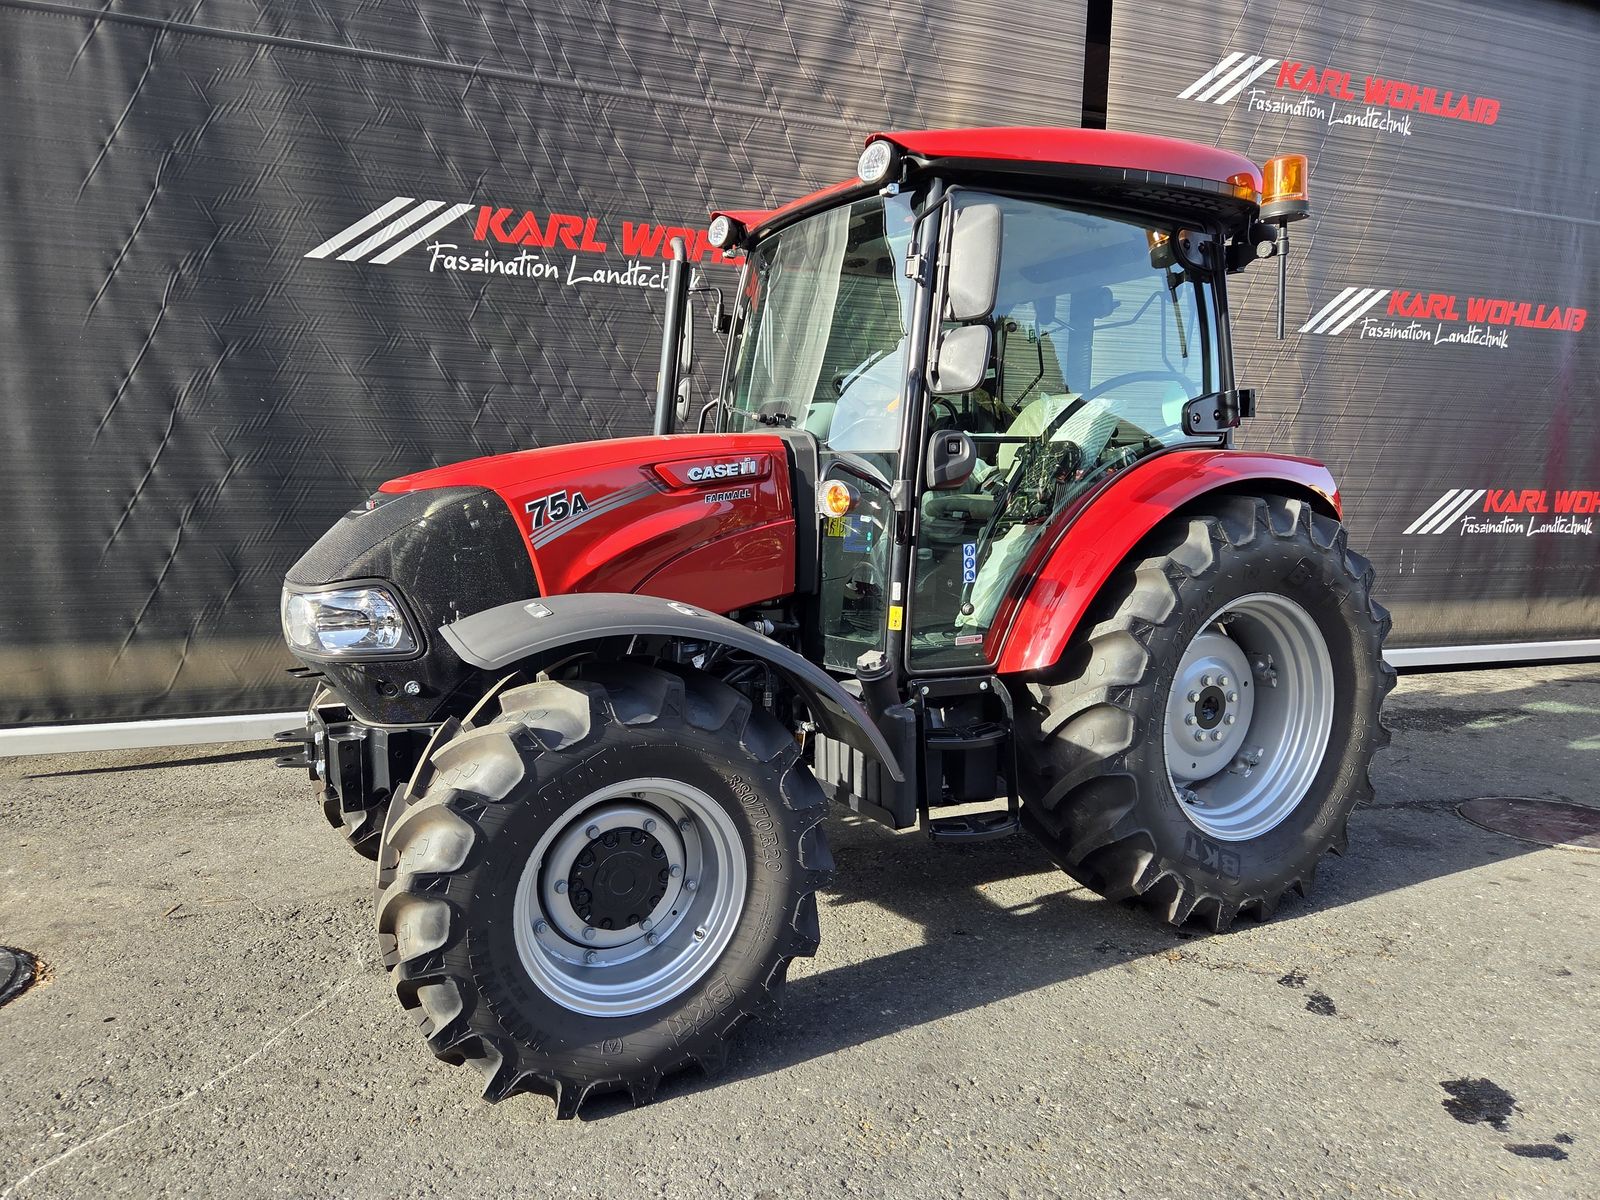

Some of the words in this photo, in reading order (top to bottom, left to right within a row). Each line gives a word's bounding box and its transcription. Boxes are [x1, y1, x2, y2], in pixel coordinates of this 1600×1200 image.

[1246, 87, 1326, 121] Faszination
[1328, 101, 1413, 137] Landtechnik
[1277, 61, 1356, 101] KARL
[1364, 78, 1502, 126] WOHLLAIB
[473, 205, 607, 253] KARL
[426, 241, 559, 279] Faszination
[1387, 291, 1459, 320] KARL
[1466, 296, 1588, 332] WOHLLAIB
[1359, 316, 1431, 341] Faszination
[1433, 321, 1510, 349] Landtechnik
[527, 490, 589, 530] 75A
[705, 489, 751, 504] FARMALL
[1484, 490, 1549, 513] KARL
[1460, 514, 1524, 537] Faszination
[1526, 515, 1593, 537] Landtechnik
[669, 976, 736, 1042] BKT
